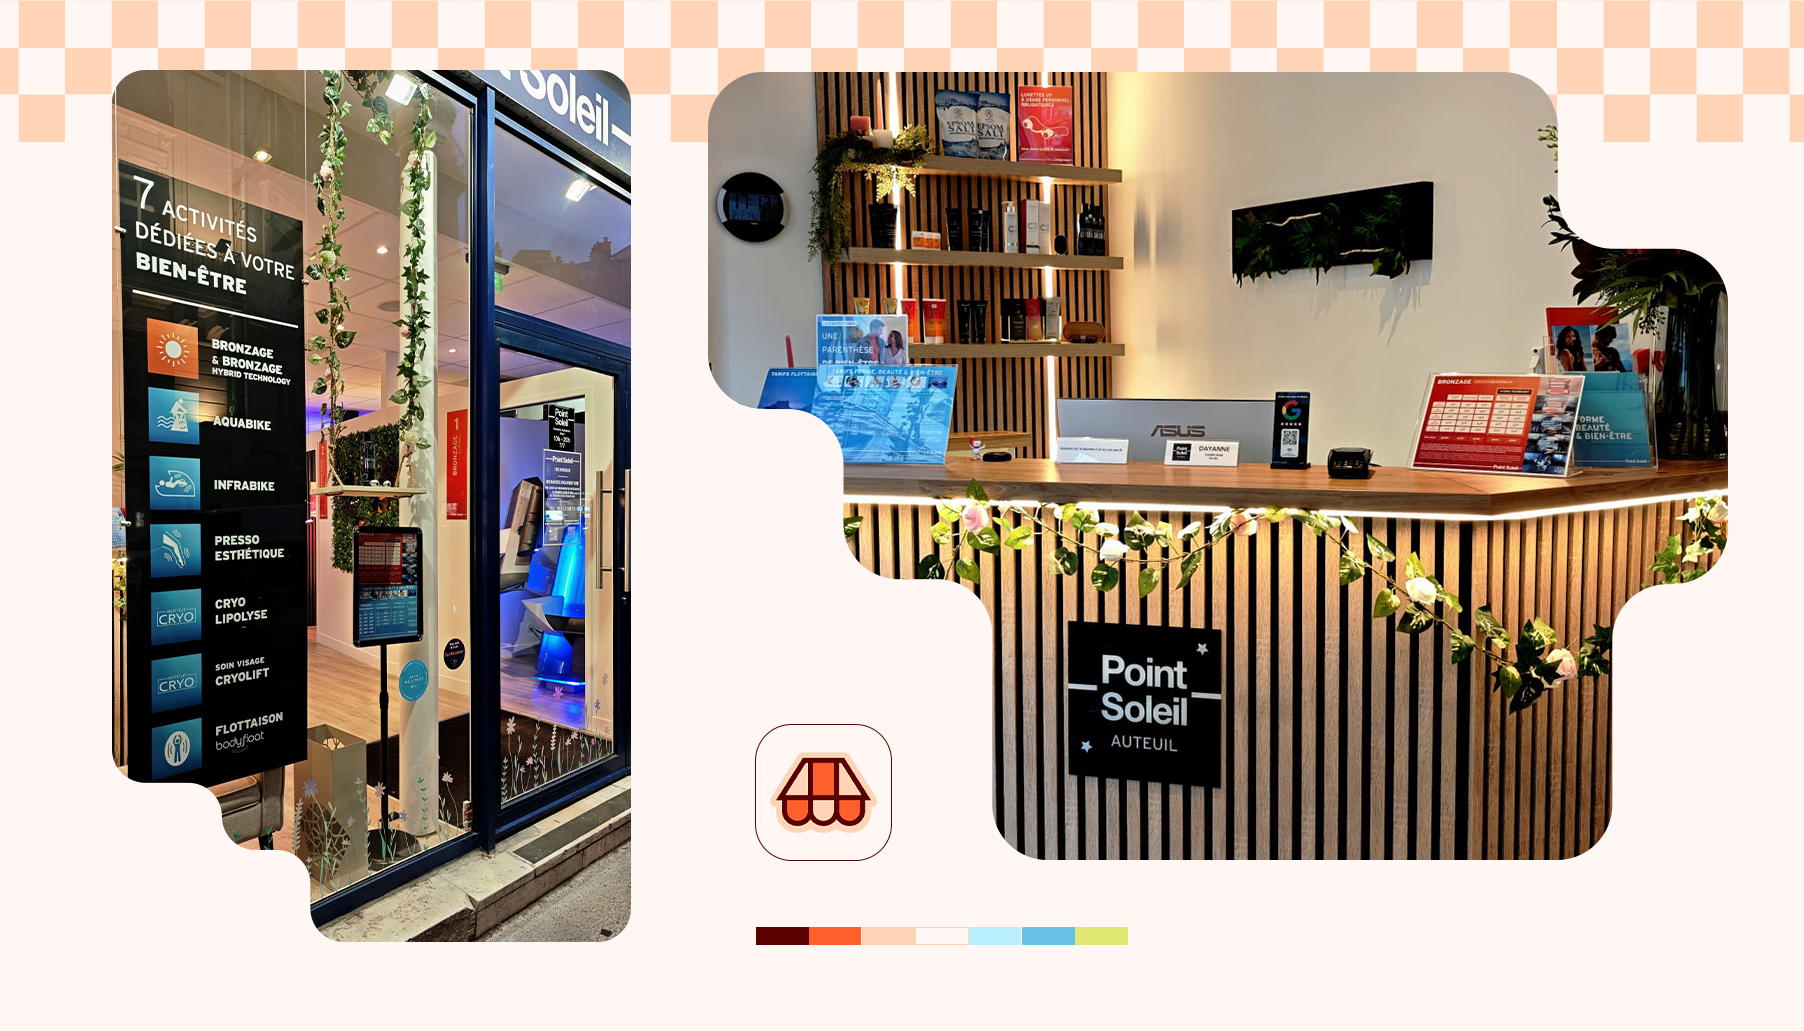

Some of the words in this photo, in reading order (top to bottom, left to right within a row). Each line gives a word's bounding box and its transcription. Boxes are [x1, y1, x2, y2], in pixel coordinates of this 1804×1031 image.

[133, 175, 155, 210] 7
[162, 200, 257, 243] ACTIVITÉS
[135, 221, 217, 260] DÉDIÉES
[224, 243, 235, 265] À
[240, 251, 295, 281] VOTRE
[136, 252, 247, 296] BIEN-ÊTRE
[212, 338, 274, 360] BRONZAGE
[822, 345, 874, 354] PARENTHÈSE
[212, 356, 219, 365] &
[222, 356, 283, 375] BRONZAGE
[212, 367, 242, 378] HYBRID
[244, 372, 291, 386] TECHNOLOGY
[213, 416, 272, 431] AQUABIKE
[1150, 425, 1205, 437] ASUS
[1576, 423, 1610, 431] BEAUTÉ
[1585, 431, 1632, 439] BIEN-ÊTRE
[214, 480, 275, 492] INFRABIKE
[214, 534, 260, 546] PRESSO
[214, 546, 284, 562] ESTHÉTIQUE
[215, 596, 246, 610] CRYO
[158, 612, 194, 625] CRYO
[215, 610, 268, 625] LIPOLYSE
[215, 662, 235, 672] SOIN
[236, 656, 265, 668] VISAGE
[1102, 654, 1187, 689] Point
[159, 677, 195, 692] CRYO
[215, 668, 270, 686] CRYOLIFT
[1101, 692, 1187, 726] Soleil
[216, 712, 284, 736] FLOTTAISON
[216, 731, 265, 751] bodyfloat
[1111, 734, 1178, 752] AUTEUIL
